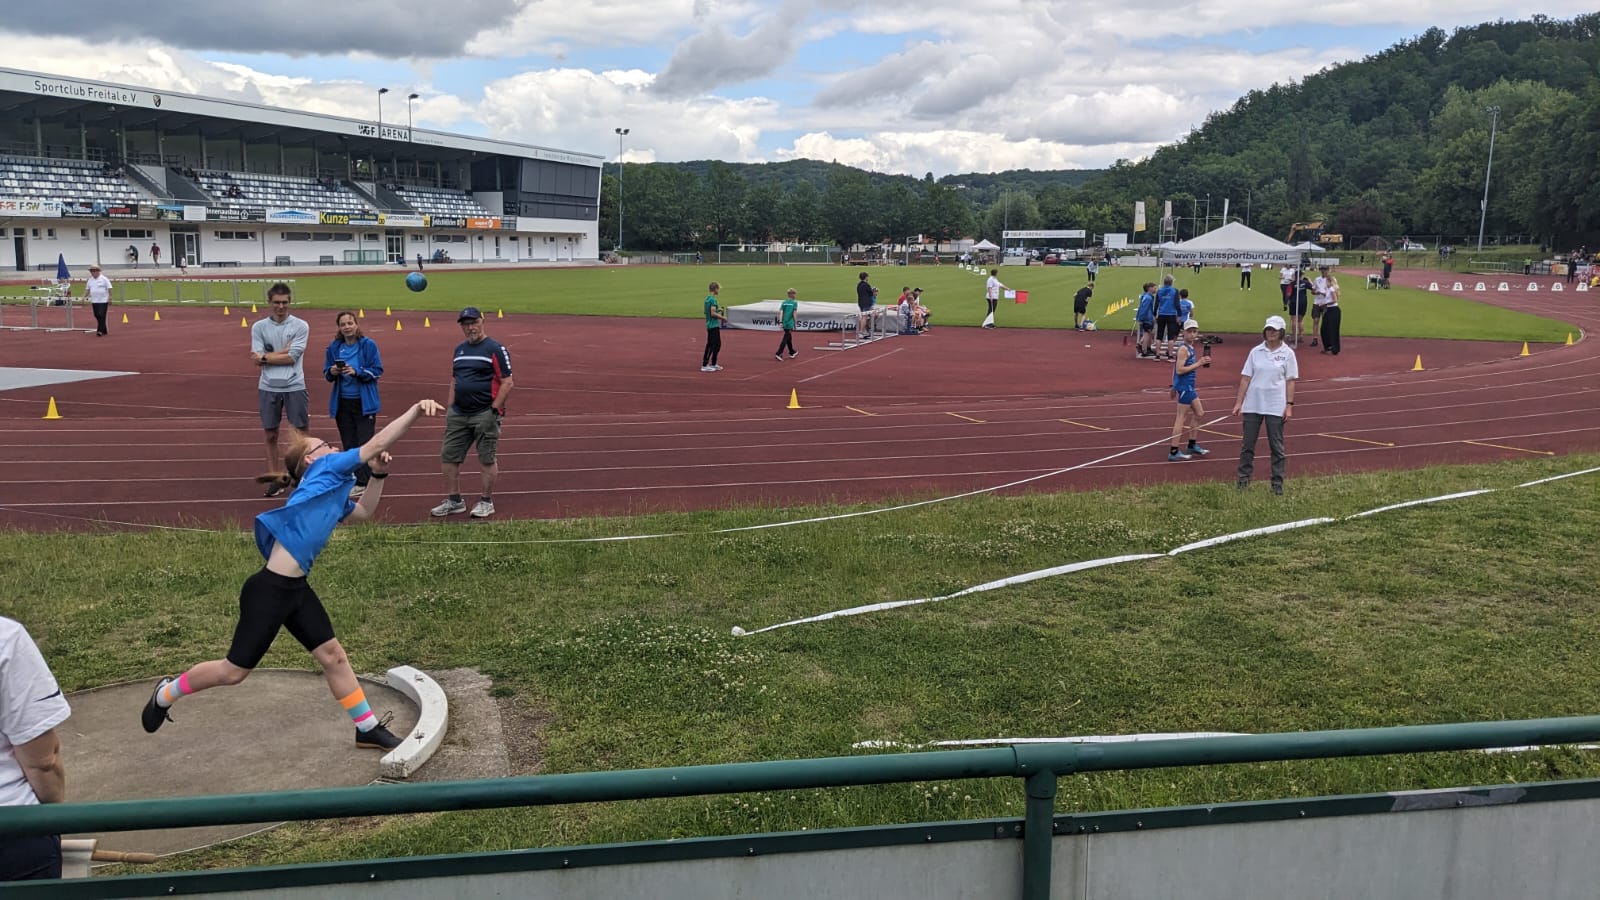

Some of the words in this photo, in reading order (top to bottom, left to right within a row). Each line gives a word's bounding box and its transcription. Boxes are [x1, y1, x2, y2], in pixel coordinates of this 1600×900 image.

[34, 80, 85, 97] Sportclub
[88, 88, 120, 101] Freital
[122, 93, 139, 103] e.V.
[381, 127, 408, 141] ARENA
[320, 211, 349, 225] Kunze
[1174, 250, 1288, 261] wwwkreissportbund.net
